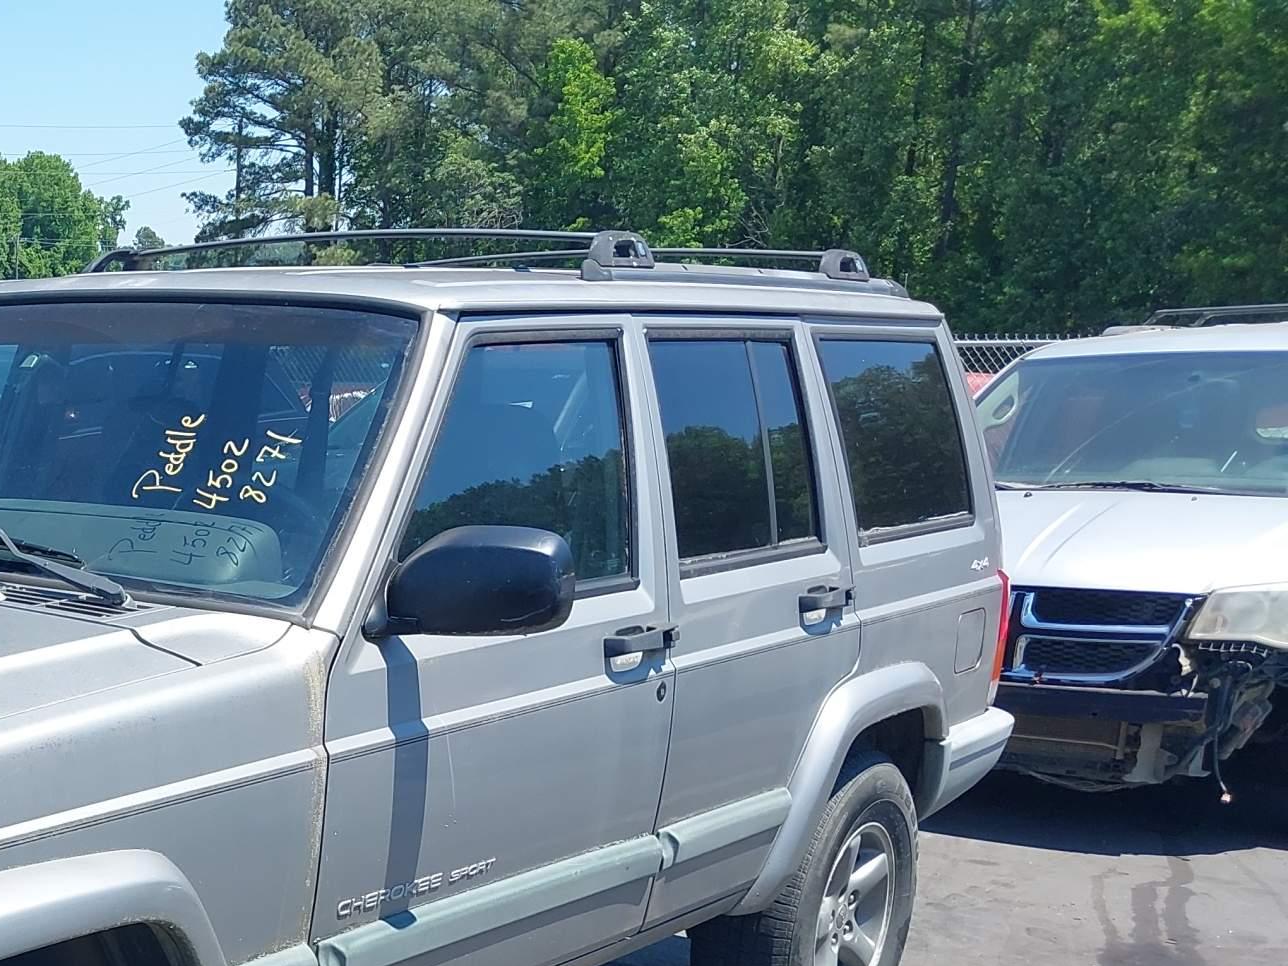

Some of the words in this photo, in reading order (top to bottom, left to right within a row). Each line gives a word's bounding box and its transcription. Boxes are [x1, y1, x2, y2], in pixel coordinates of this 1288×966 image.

[132, 413, 206, 499] Peddle
[192, 438, 250, 510] 4502
[337, 872, 444, 918] CHEROKEE
[448, 857, 497, 884] SPORT
